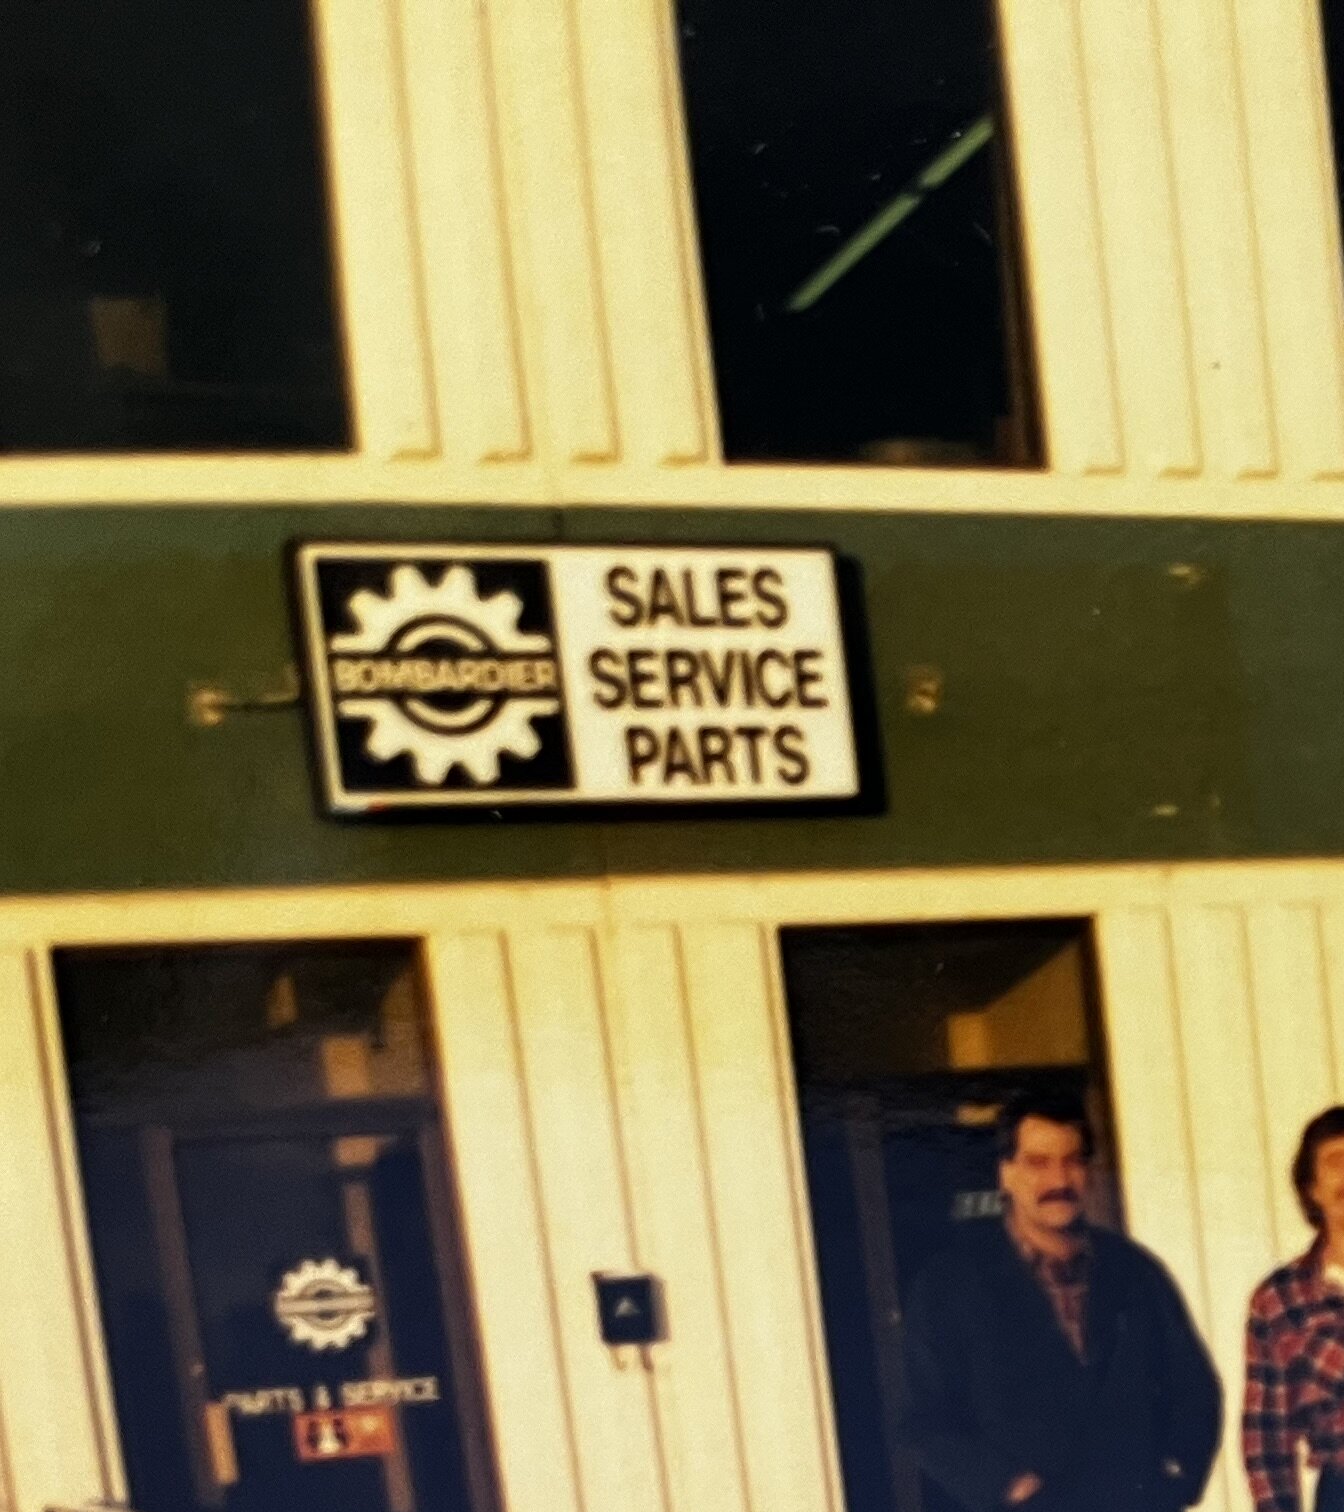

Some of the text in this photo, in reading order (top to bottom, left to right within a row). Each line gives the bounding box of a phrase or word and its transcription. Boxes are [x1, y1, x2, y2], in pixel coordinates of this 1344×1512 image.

[605, 566, 788, 628] SALES
[333, 657, 560, 692] BOMBARDIER
[589, 648, 829, 710] SERVICE
[625, 725, 812, 786] PARTS
